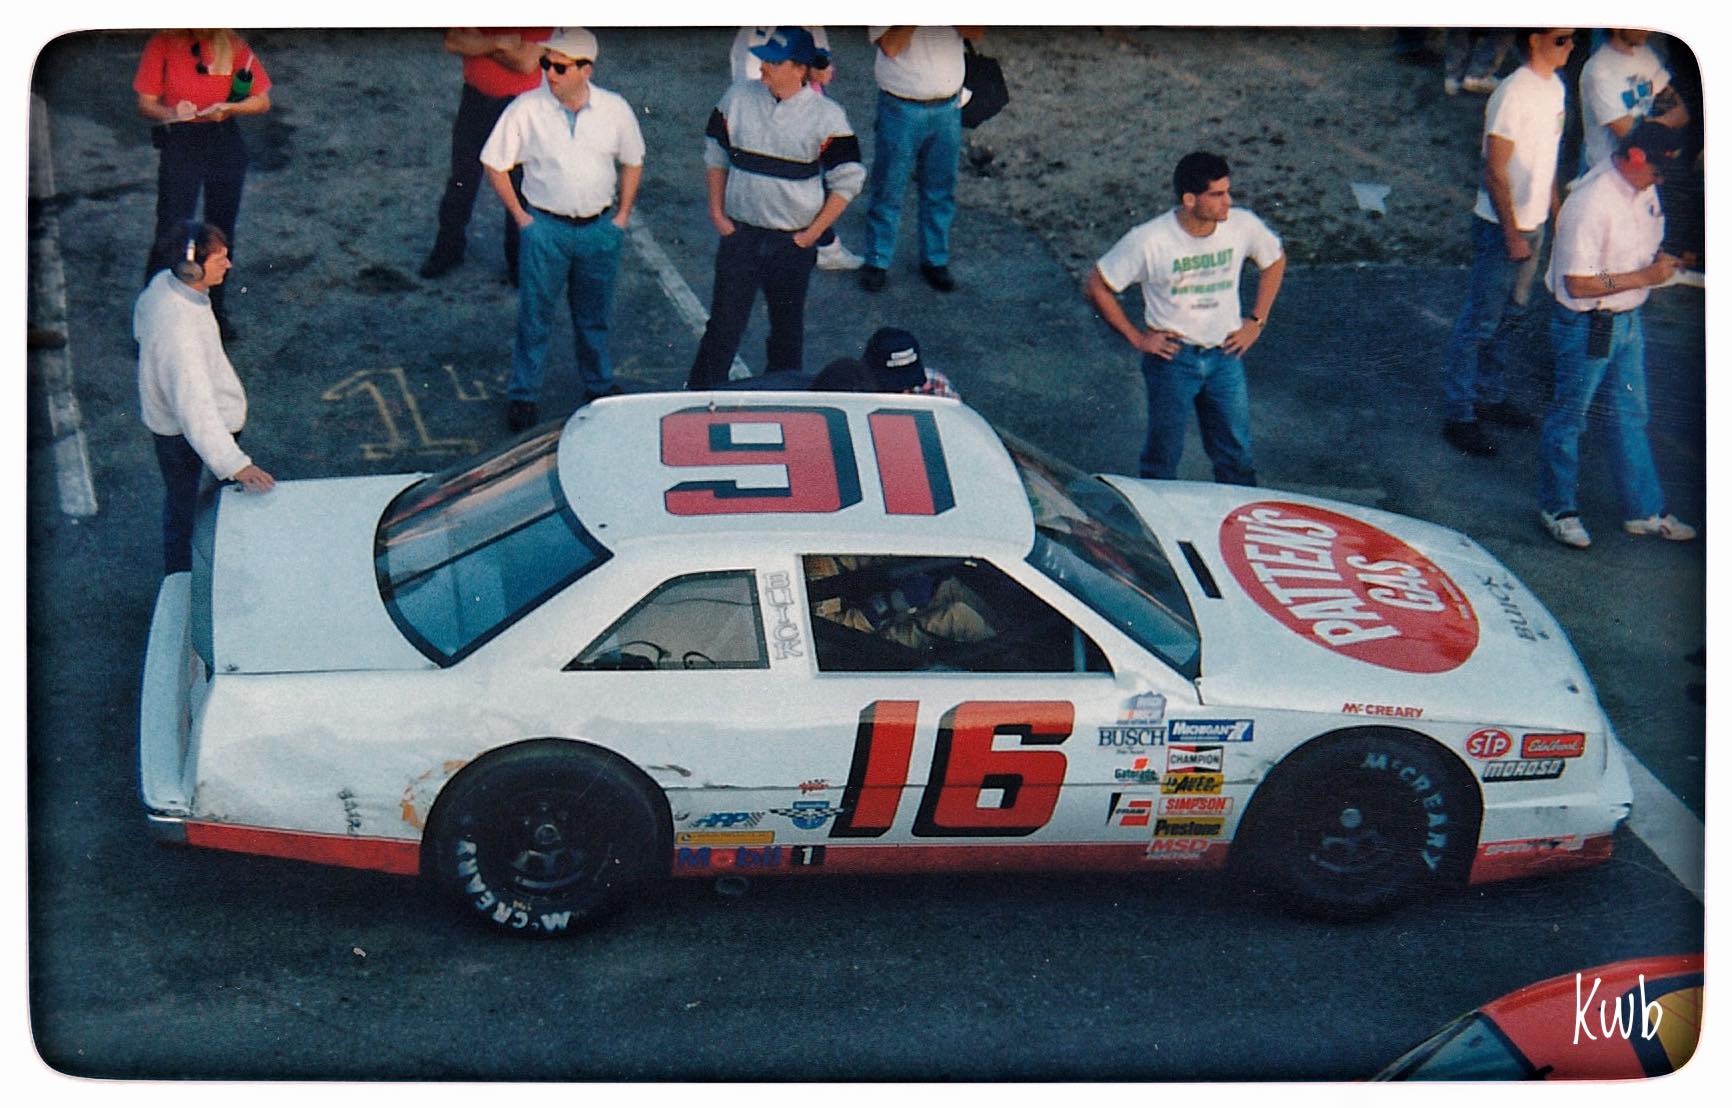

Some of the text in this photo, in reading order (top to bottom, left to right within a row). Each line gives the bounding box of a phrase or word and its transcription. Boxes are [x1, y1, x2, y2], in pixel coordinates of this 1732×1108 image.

[1172, 247, 1233, 273] ABSOLUT
[1238, 508, 1400, 647] PATTEN'S
[1346, 555, 1446, 612] GAS
[763, 571, 804, 660] BUICK
[1475, 573, 1537, 641] BUICK
[1098, 727, 1166, 747] BUSCH
[1468, 731, 1507, 755] STP
[828, 699, 1076, 838] 16
[1169, 754, 1220, 765] CHAMPION
[1483, 758, 1561, 778] MOROSO
[1165, 798, 1227, 810] SIMPSON
[1153, 819, 1222, 837] Prestone
[1151, 838, 1210, 852] MSD
